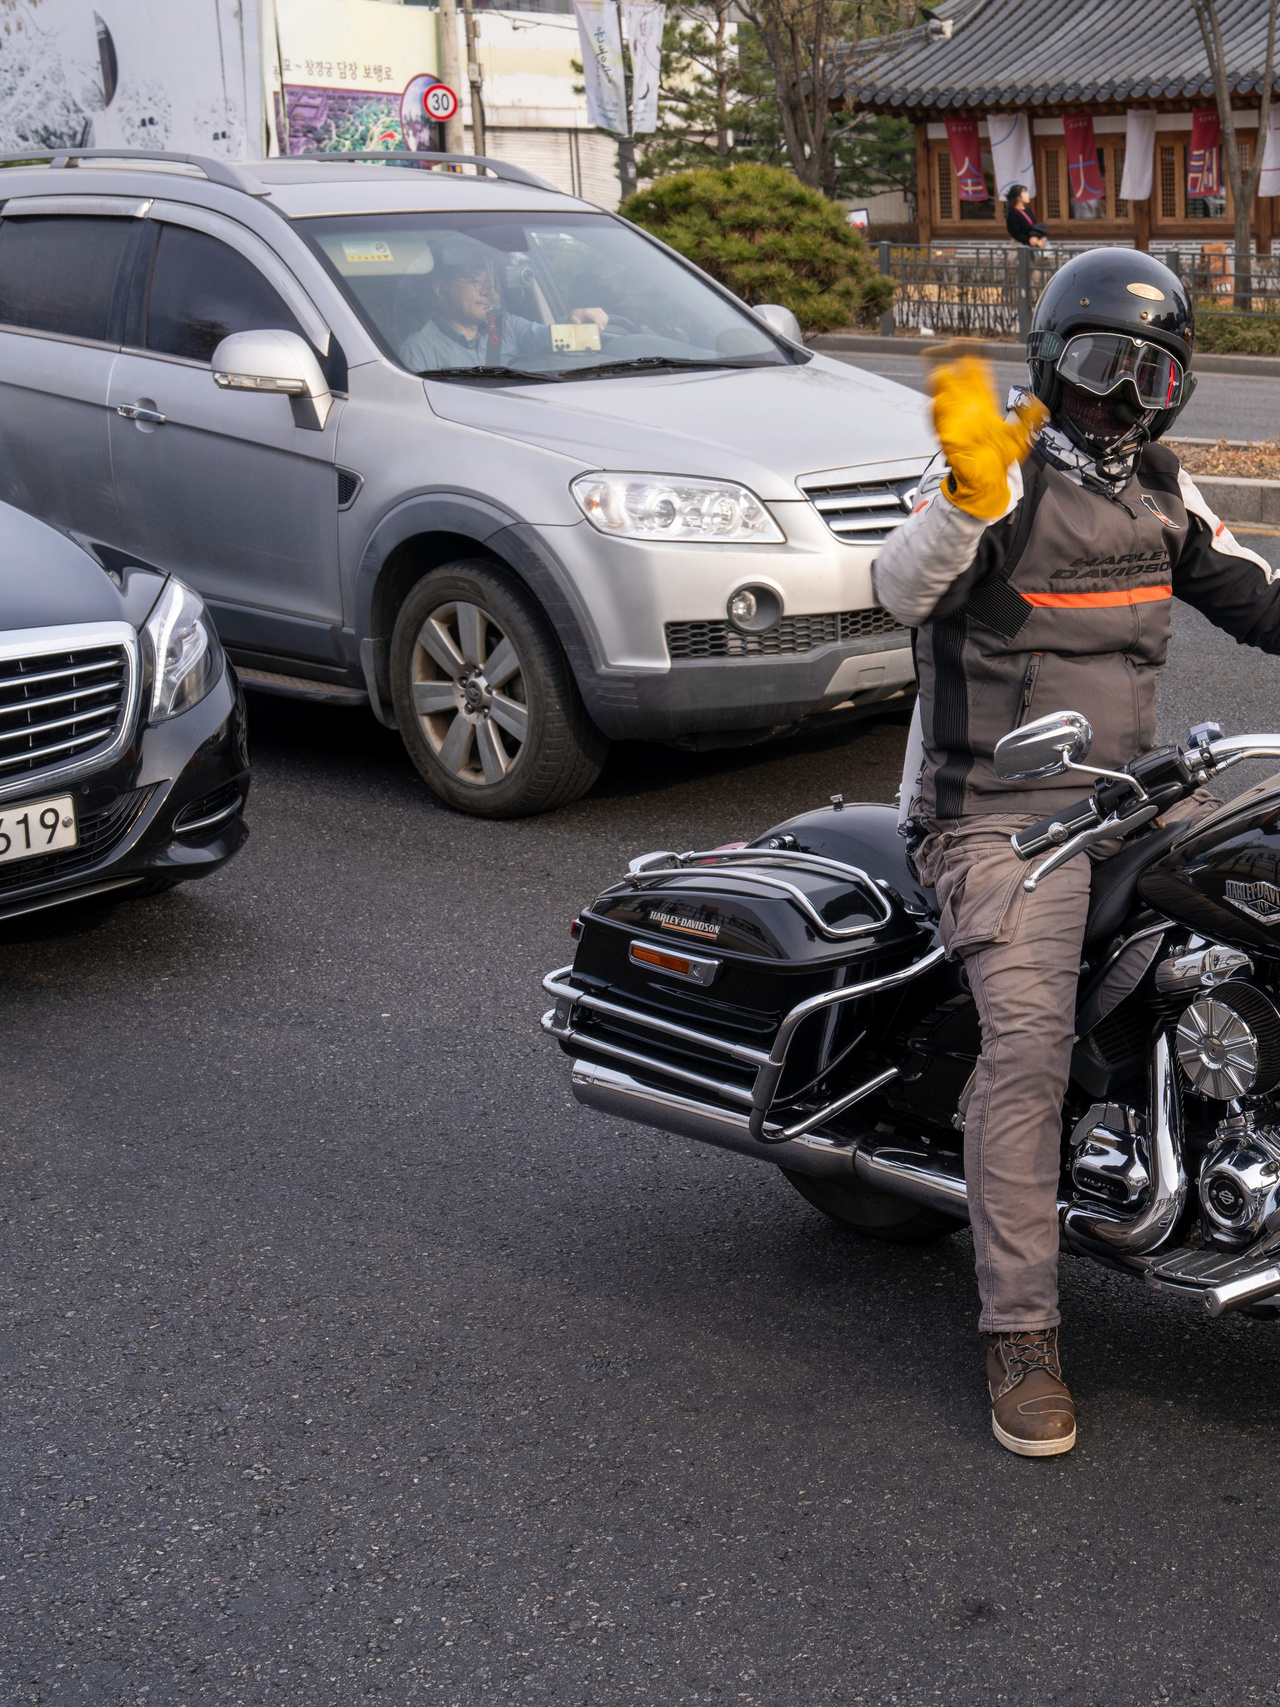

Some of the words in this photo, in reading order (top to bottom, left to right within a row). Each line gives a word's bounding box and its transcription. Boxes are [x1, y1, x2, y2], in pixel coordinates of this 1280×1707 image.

[304, 60, 334, 77] 창경궁
[337, 61, 359, 80] 담장
[363, 65, 394, 83] 보행로
[431, 93, 450, 111] 30
[1069, 550, 1168, 568] HARLEY
[1050, 562, 1172, 580] DAVIDSO
[649, 910, 721, 934] HARLEY-DAVIDSON
